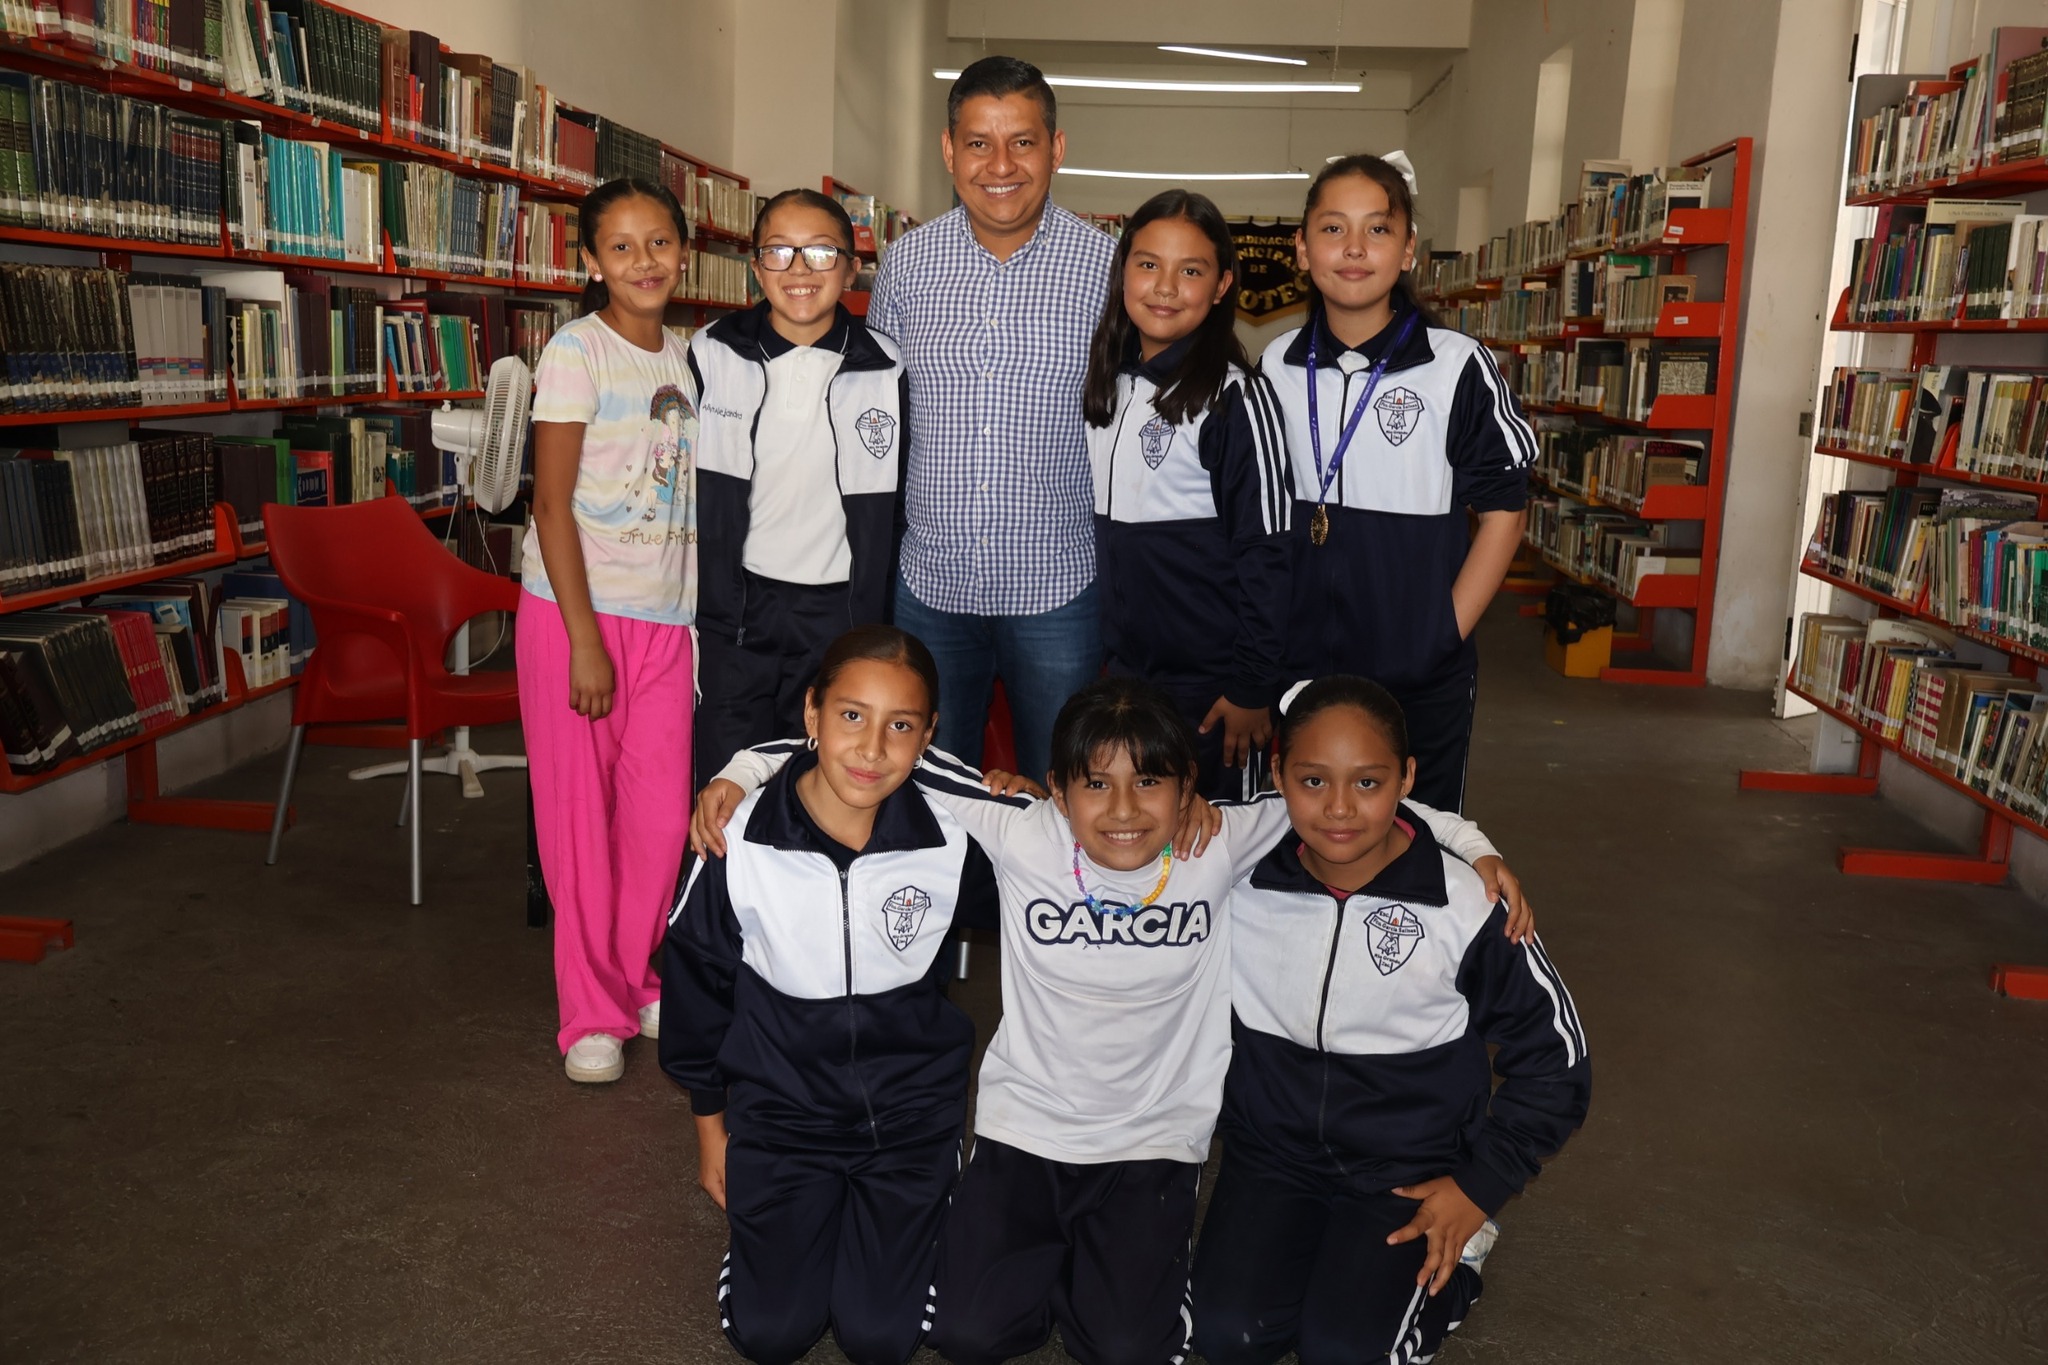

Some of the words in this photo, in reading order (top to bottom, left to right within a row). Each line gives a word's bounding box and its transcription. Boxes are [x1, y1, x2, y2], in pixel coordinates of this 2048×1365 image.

[1249, 264, 1268, 274] DE
[1238, 271, 1310, 310] OTEC
[619, 527, 664, 546] True
[1025, 898, 1211, 948] GARCIA
